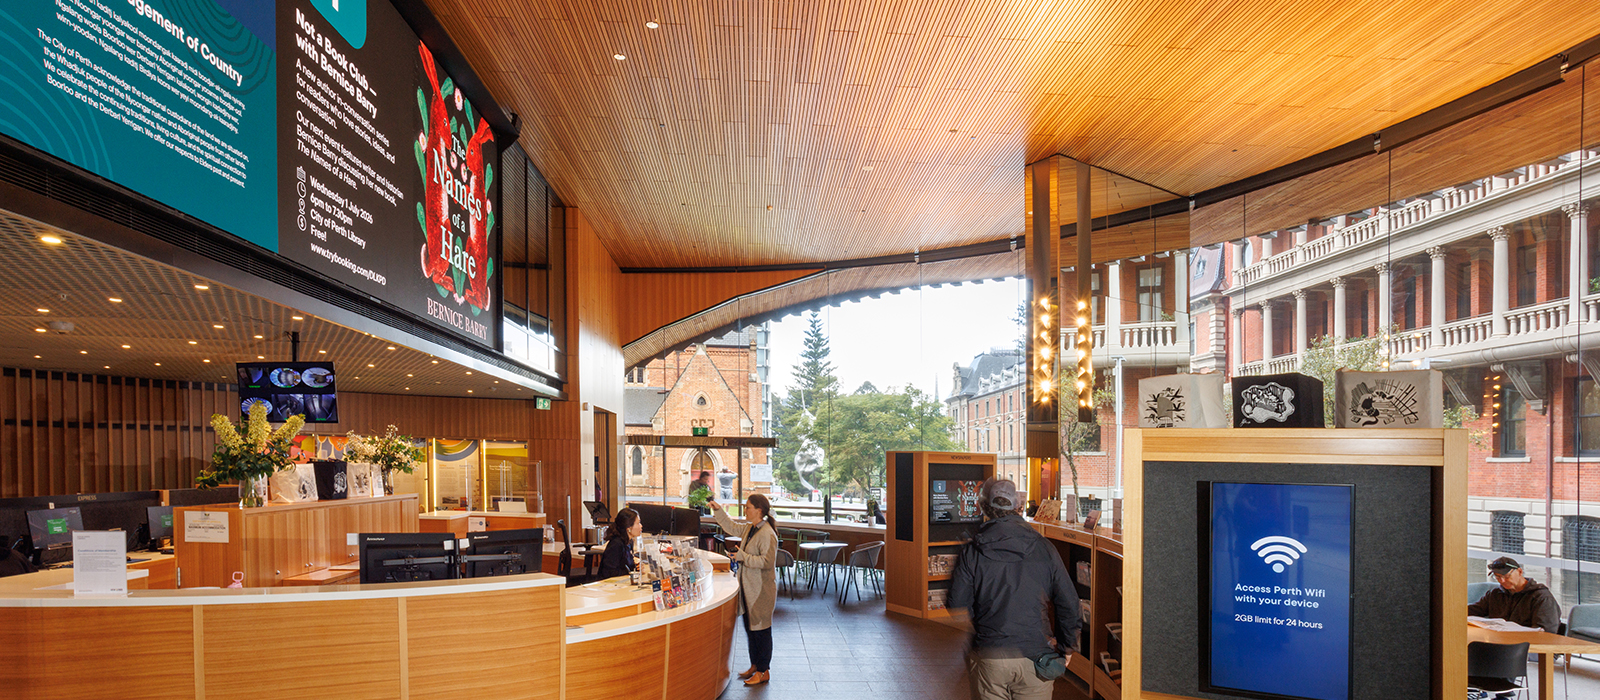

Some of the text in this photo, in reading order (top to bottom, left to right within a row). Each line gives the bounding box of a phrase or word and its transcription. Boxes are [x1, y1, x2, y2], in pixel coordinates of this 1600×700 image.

[103, 28, 126, 49] Boorloo
[136, 51, 156, 69] Derbarl
[156, 64, 176, 82] Yerrigan
[159, 56, 183, 76] Aboriginal
[186, 36, 199, 52] of
[200, 44, 242, 86] Country
[296, 8, 315, 40] Not
[317, 34, 322, 47] a
[325, 37, 348, 72] Book
[349, 63, 368, 90] Club
[37, 28, 51, 43] The
[52, 38, 66, 53] City
[75, 51, 92, 68] Perth
[93, 64, 130, 91] acknowledge
[132, 86, 141, 97] the
[141, 92, 166, 112] traditional
[166, 108, 192, 127] custodians
[204, 130, 214, 140] land
[228, 145, 243, 158] situated
[296, 34, 377, 118] with Bernice Barry
[43, 59, 55, 72] We
[56, 68, 87, 90] celebrate
[88, 85, 98, 96] the
[99, 92, 130, 115] continuing
[130, 109, 156, 128] traditions,
[156, 123, 170, 137] living
[170, 132, 188, 146] culture,
[188, 142, 196, 150] and
[204, 152, 220, 164] spiritual
[220, 161, 242, 176] connection
[44, 46, 56, 59] the
[56, 53, 85, 76] Whadjuk
[86, 72, 107, 89] people
[114, 88, 124, 99] the
[125, 94, 151, 114] Nyoongar
[151, 110, 167, 123] nation
[168, 120, 177, 130] and
[177, 124, 200, 142] Aboriginal
[200, 139, 214, 151] people
[214, 146, 224, 156] from
[224, 154, 235, 162] other
[47, 74, 73, 95] Boorloo
[74, 91, 86, 102] and
[88, 97, 98, 108] the
[99, 102, 120, 120] Derbarl
[121, 115, 144, 133] Yerrigan.
[144, 128, 153, 138] We
[154, 134, 165, 144] offer
[174, 146, 194, 160] respects
[199, 158, 212, 170] Elders
[212, 166, 222, 176] past
[296, 58, 389, 147] A new author in-conversation series
[296, 91, 337, 129] conversation.
[296, 73, 395, 164] for readers who love stories, ideas, and
[297, 110, 403, 199] Our next event features writer and historian
[297, 139, 310, 156] The
[311, 149, 331, 171] Names
[332, 167, 339, 176] of
[344, 172, 357, 190] Hare.
[297, 124, 396, 206] Bernice Barry discussing her new book,
[452, 134, 466, 160] The
[310, 176, 345, 208] Wednesday
[348, 202, 360, 217] July
[360, 208, 373, 224] 2026
[310, 193, 352, 226] 6pm to 7.30pm
[433, 148, 482, 221] Names
[310, 209, 366, 249] City of Perth Library
[311, 224, 326, 242] Free!
[452, 214, 466, 232] of a
[440, 225, 476, 278] Hare
[427, 298, 488, 340] BERNICE BARRY
[1235, 584, 1326, 598] Access Perth Wifi
[1284, 599, 1319, 608] device
[1235, 614, 1253, 622] 2GB
[1255, 616, 1272, 624] limit
[1273, 617, 1284, 625] for
[1298, 620, 1323, 629] hours
